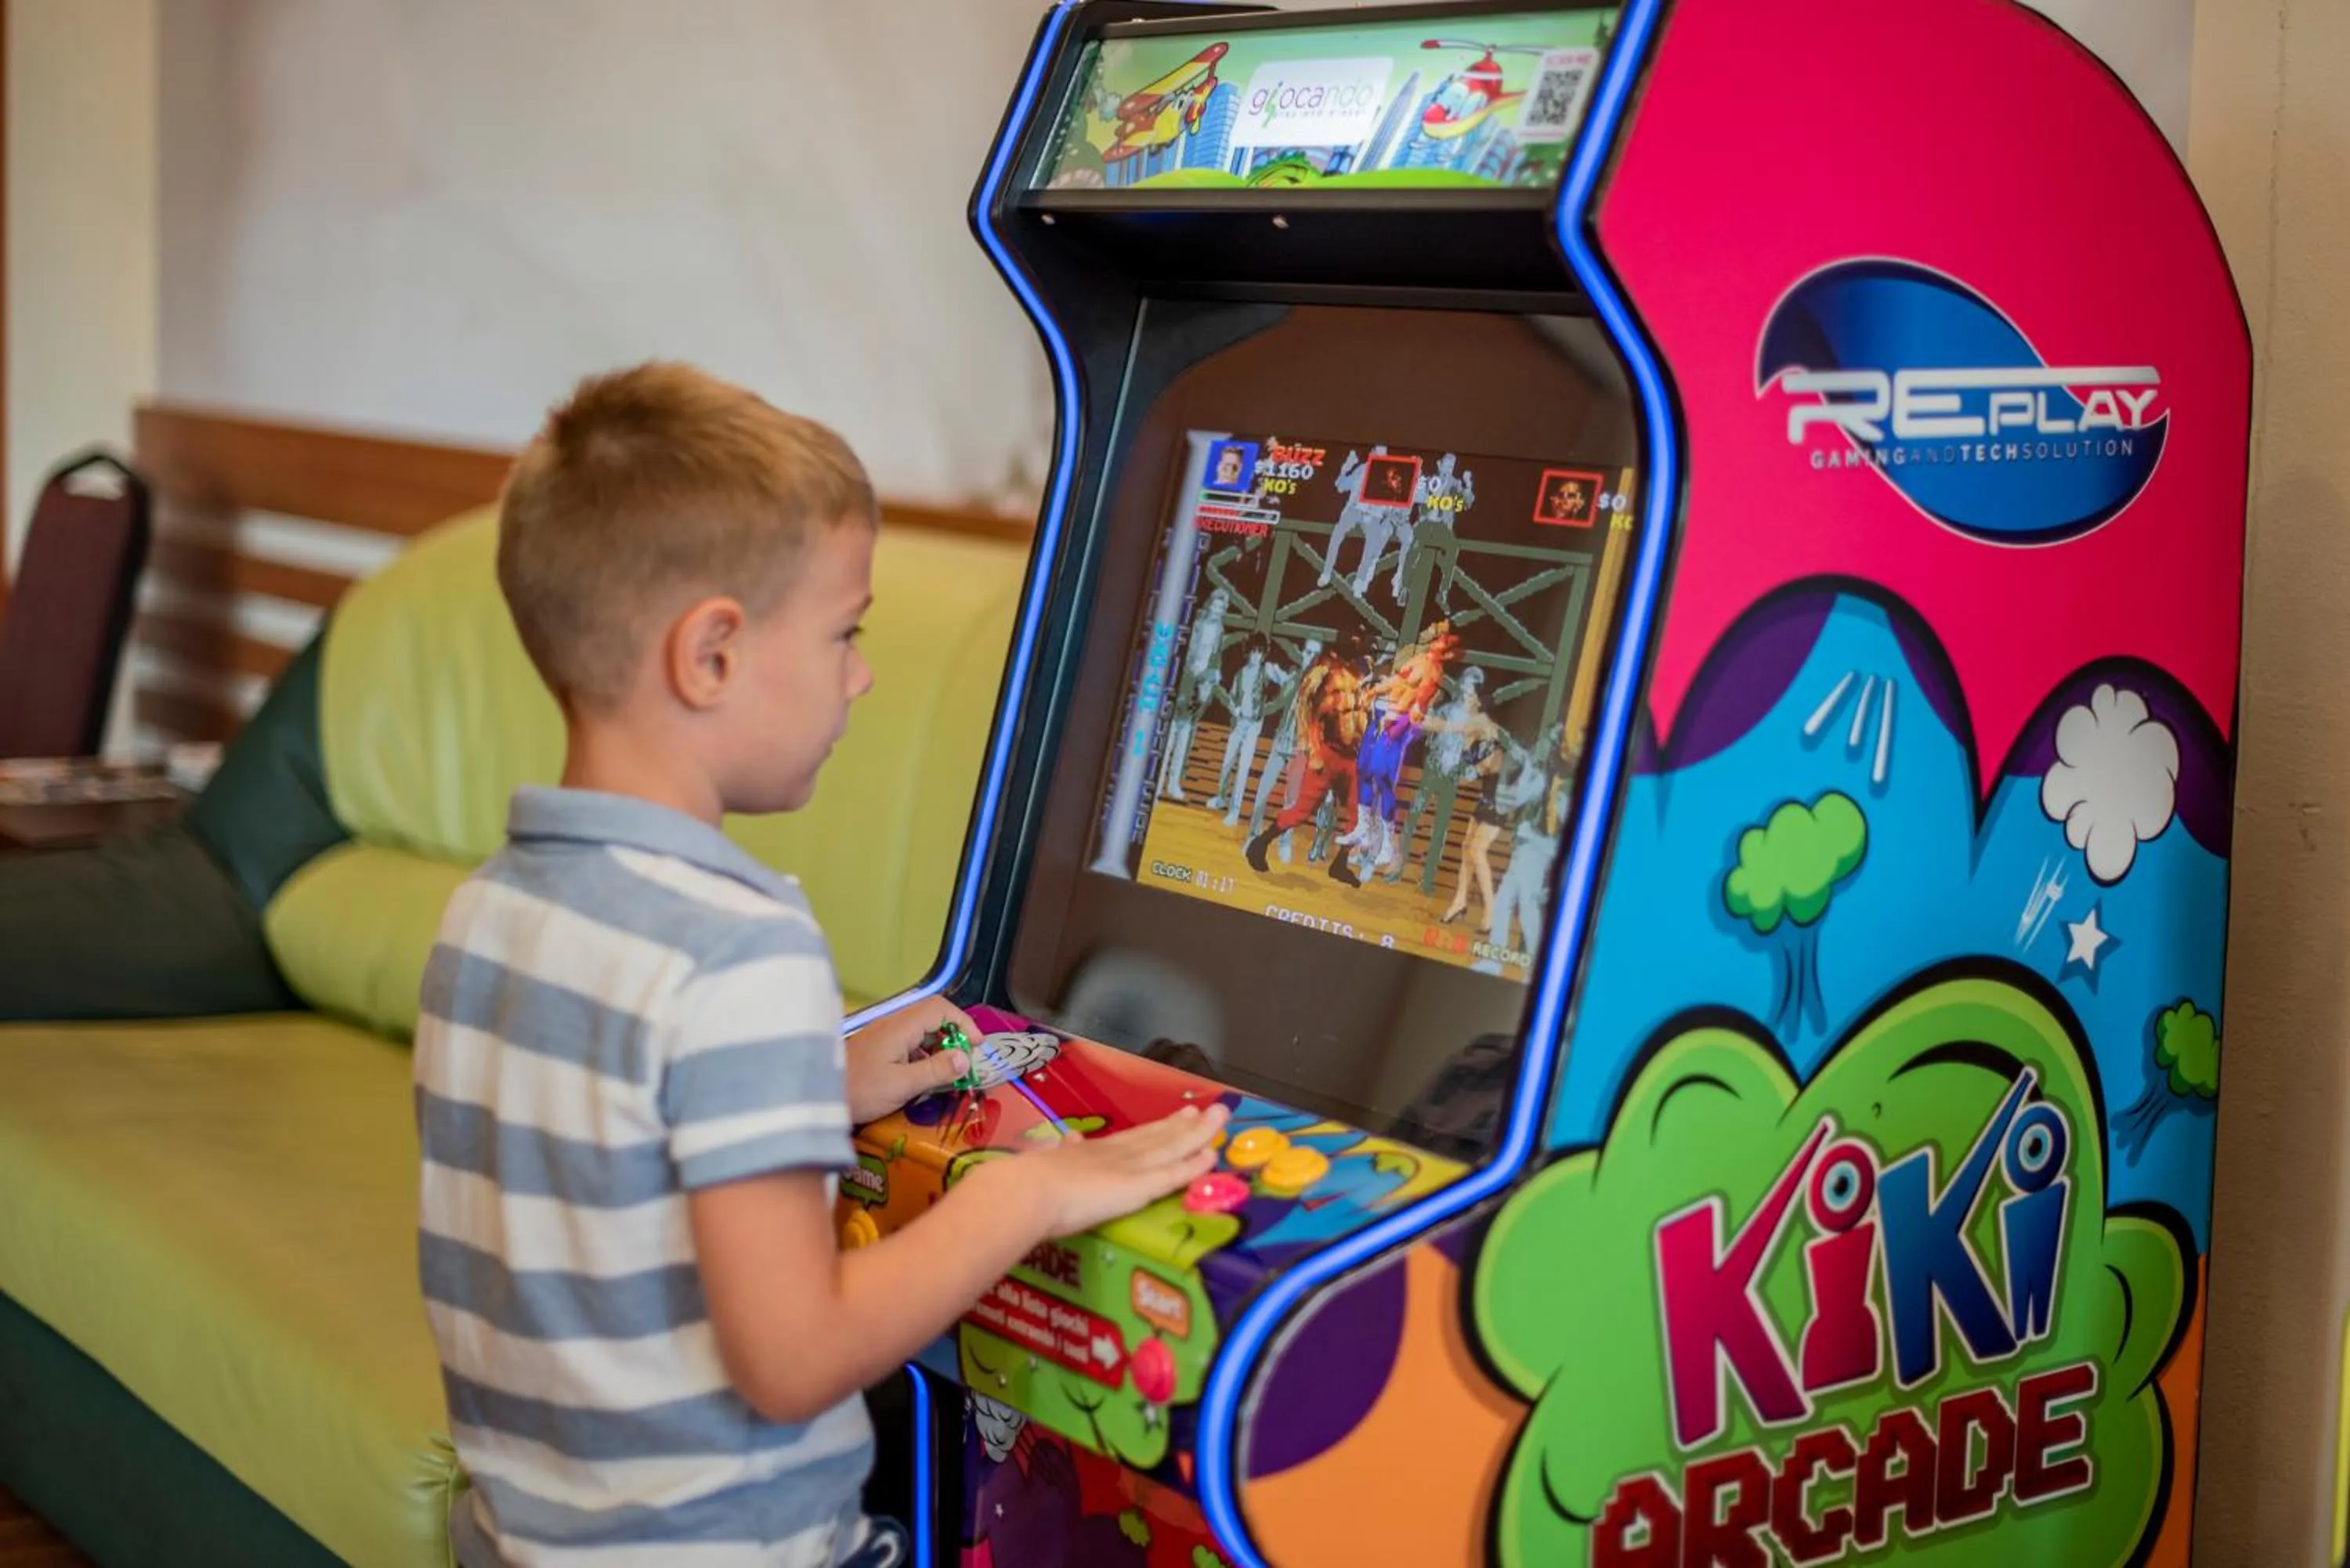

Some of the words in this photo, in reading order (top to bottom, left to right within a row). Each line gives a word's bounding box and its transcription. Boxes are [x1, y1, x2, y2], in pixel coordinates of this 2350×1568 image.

[1248, 78, 1373, 128] giocando
[1271, 446, 1326, 466] BUZZ
[1262, 479, 1297, 495] KO's
[1427, 494, 1464, 511] KO's
[1152, 862, 1191, 882] CLOCK
[1473, 941, 1531, 967] RECORD
[1588, 1362, 2099, 1568] ARCADE
